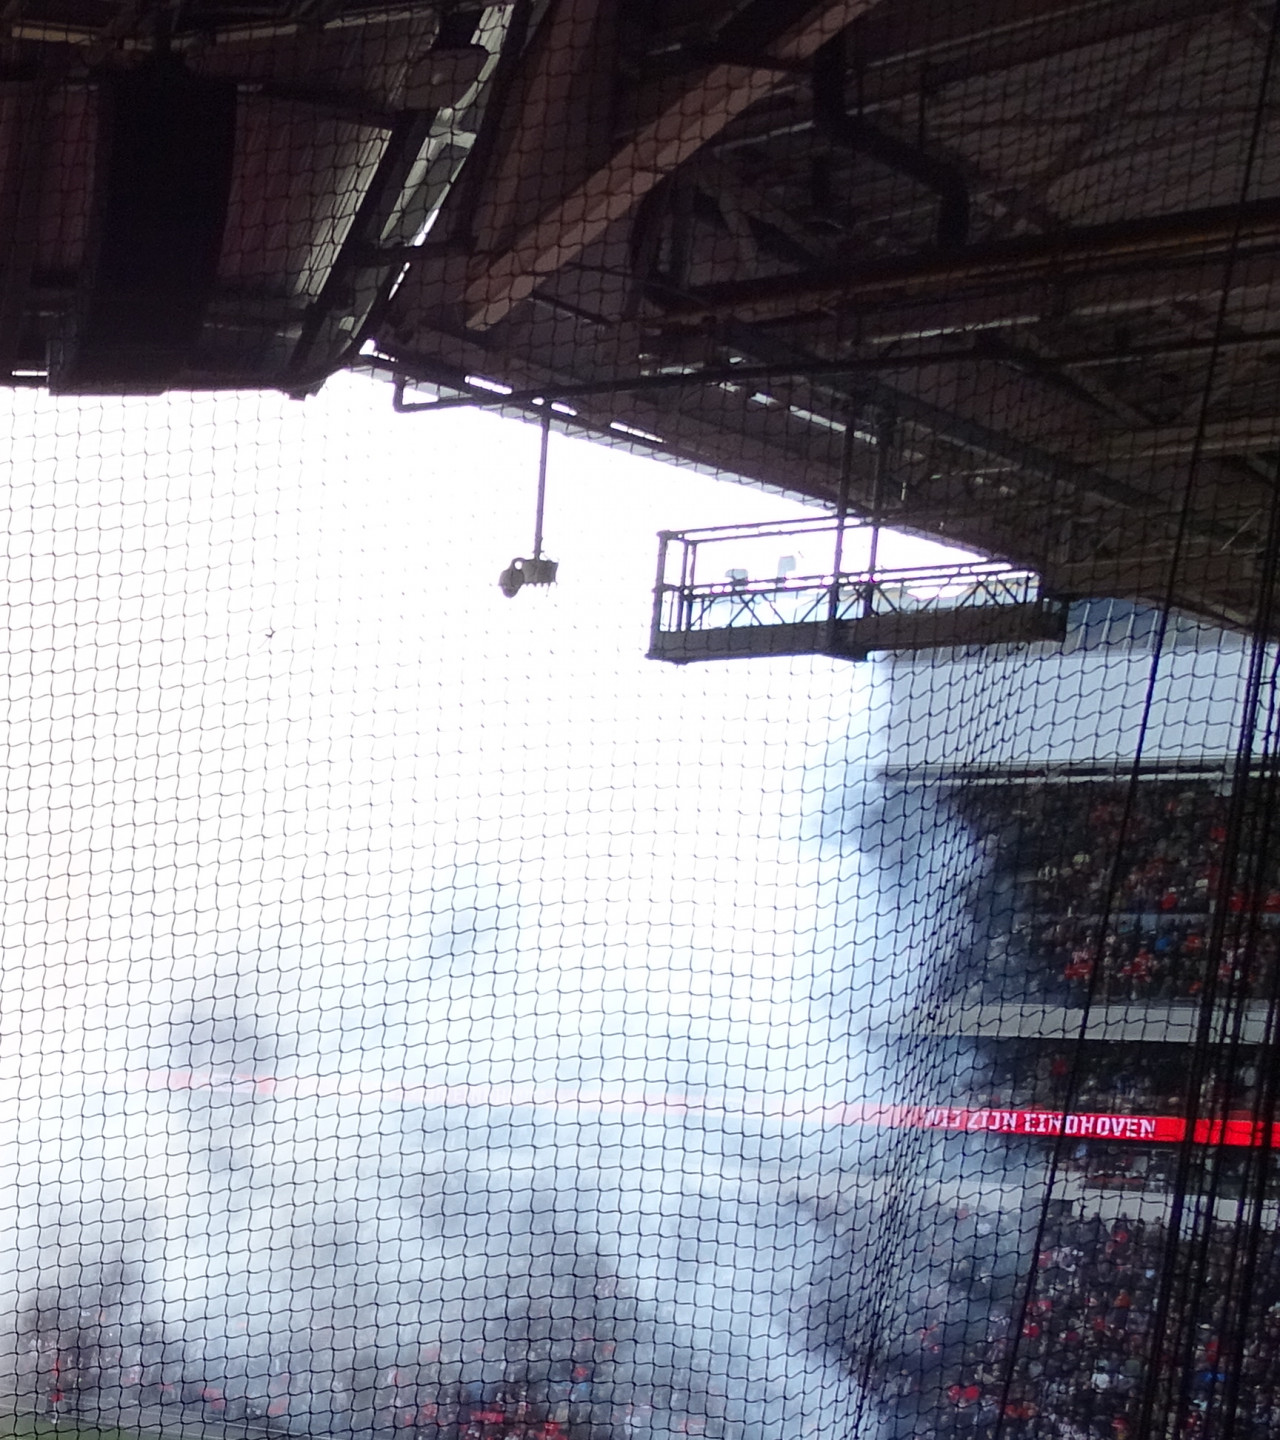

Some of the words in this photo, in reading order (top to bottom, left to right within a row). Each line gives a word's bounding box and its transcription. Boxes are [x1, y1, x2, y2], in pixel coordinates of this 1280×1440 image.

[923, 1107, 960, 1127] WIJ
[966, 1110, 1016, 1132] ZIJN
[1023, 1112, 1155, 1139] EINDHOVEN
